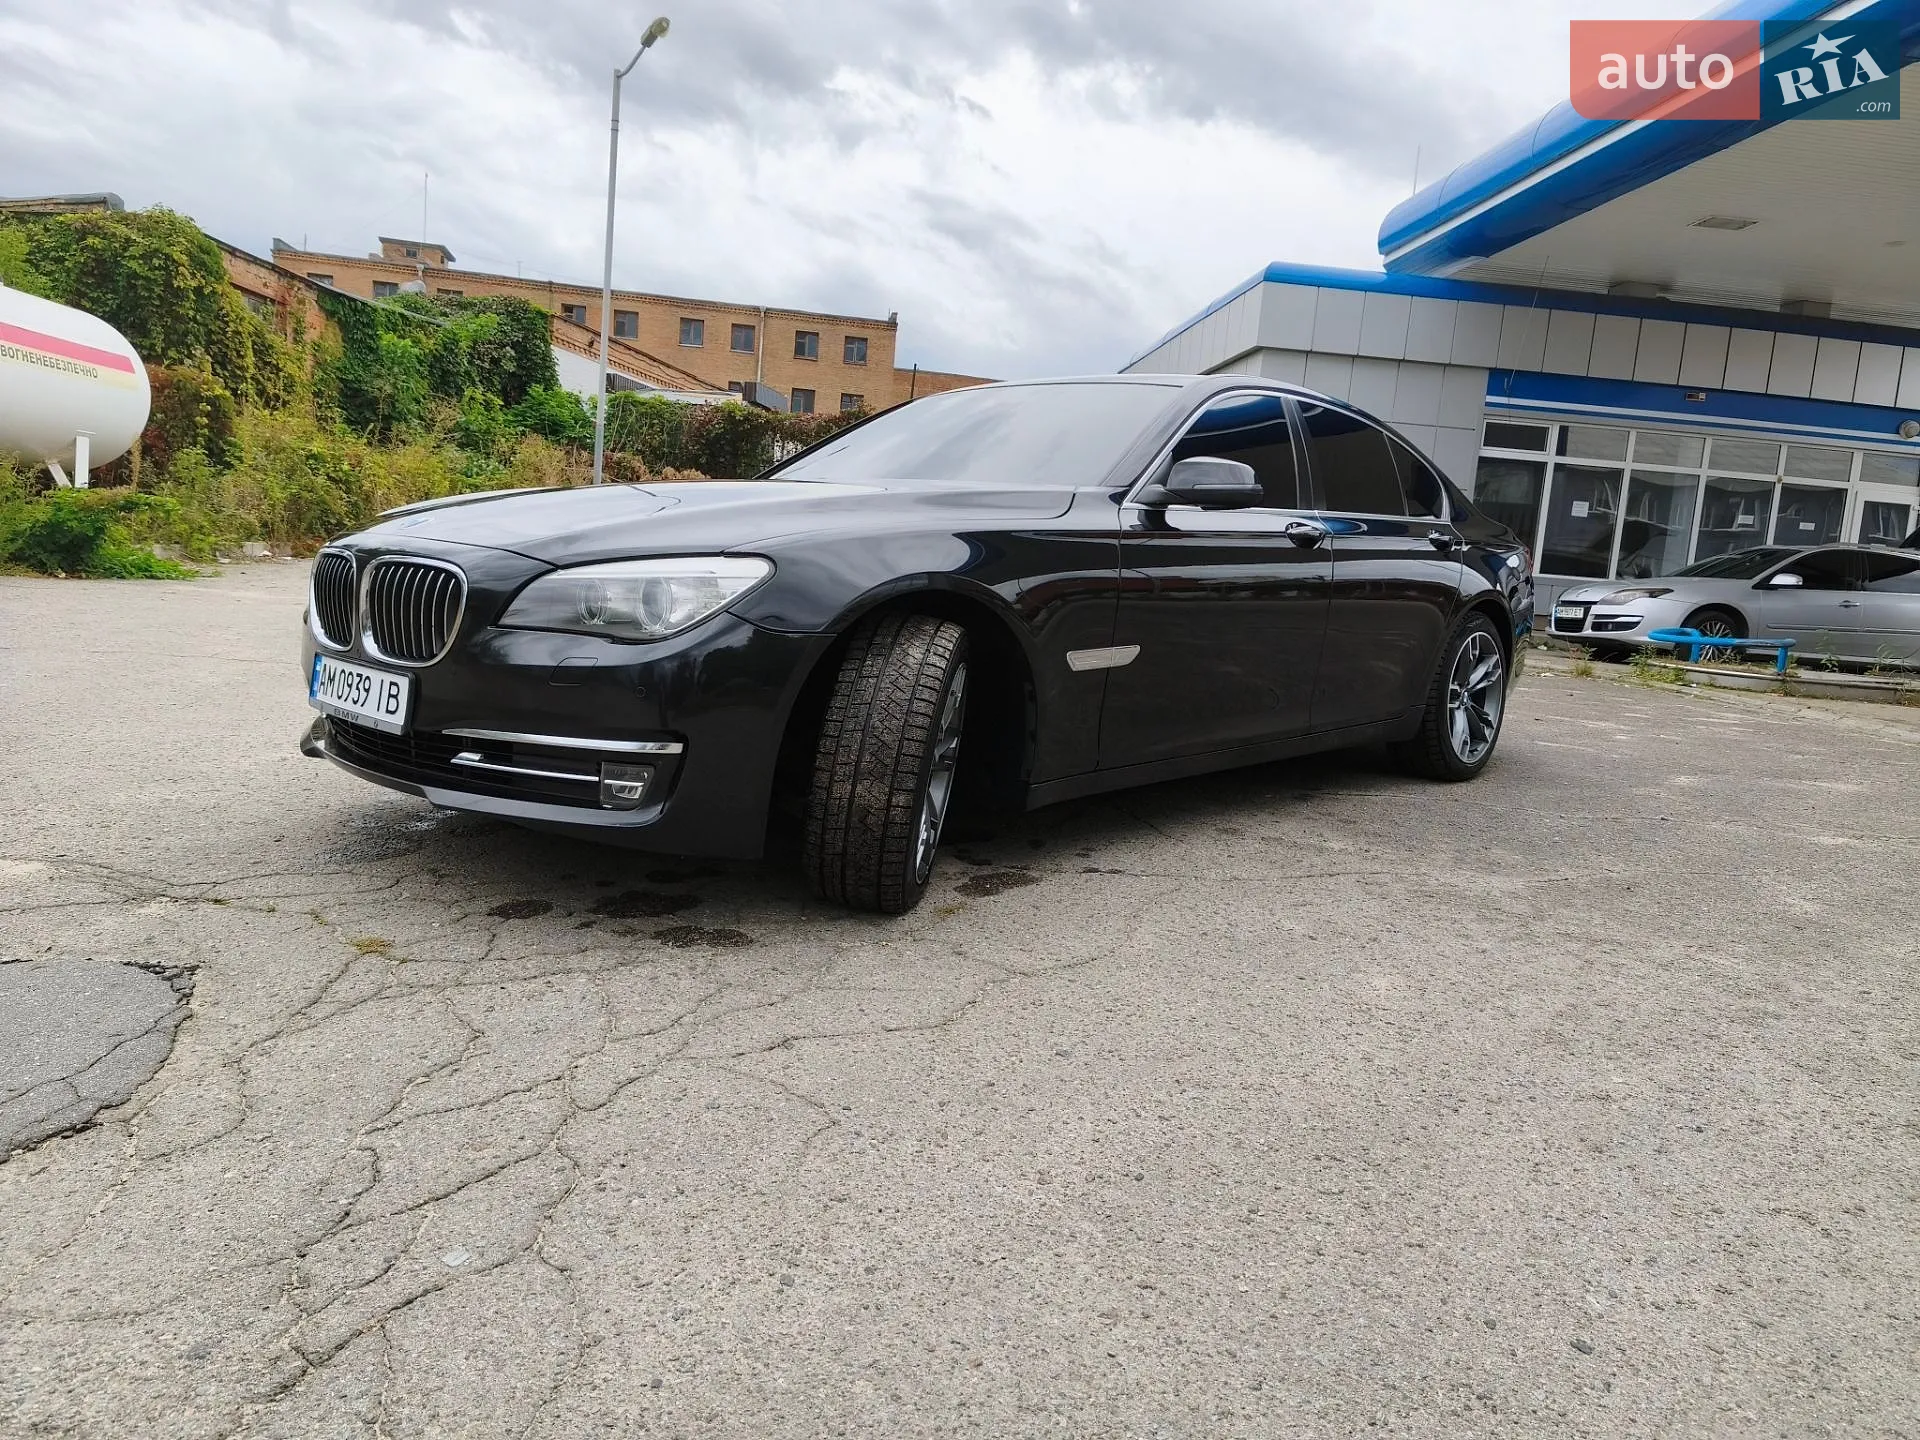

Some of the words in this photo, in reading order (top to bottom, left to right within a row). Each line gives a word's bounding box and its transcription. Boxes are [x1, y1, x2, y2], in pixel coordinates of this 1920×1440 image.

[0, 344, 98, 379] ВОГНЕНЕБЕЗПЕЧНО
[319, 663, 337, 698] AM
[336, 668, 372, 707] 0939
[376, 678, 401, 715] IB
